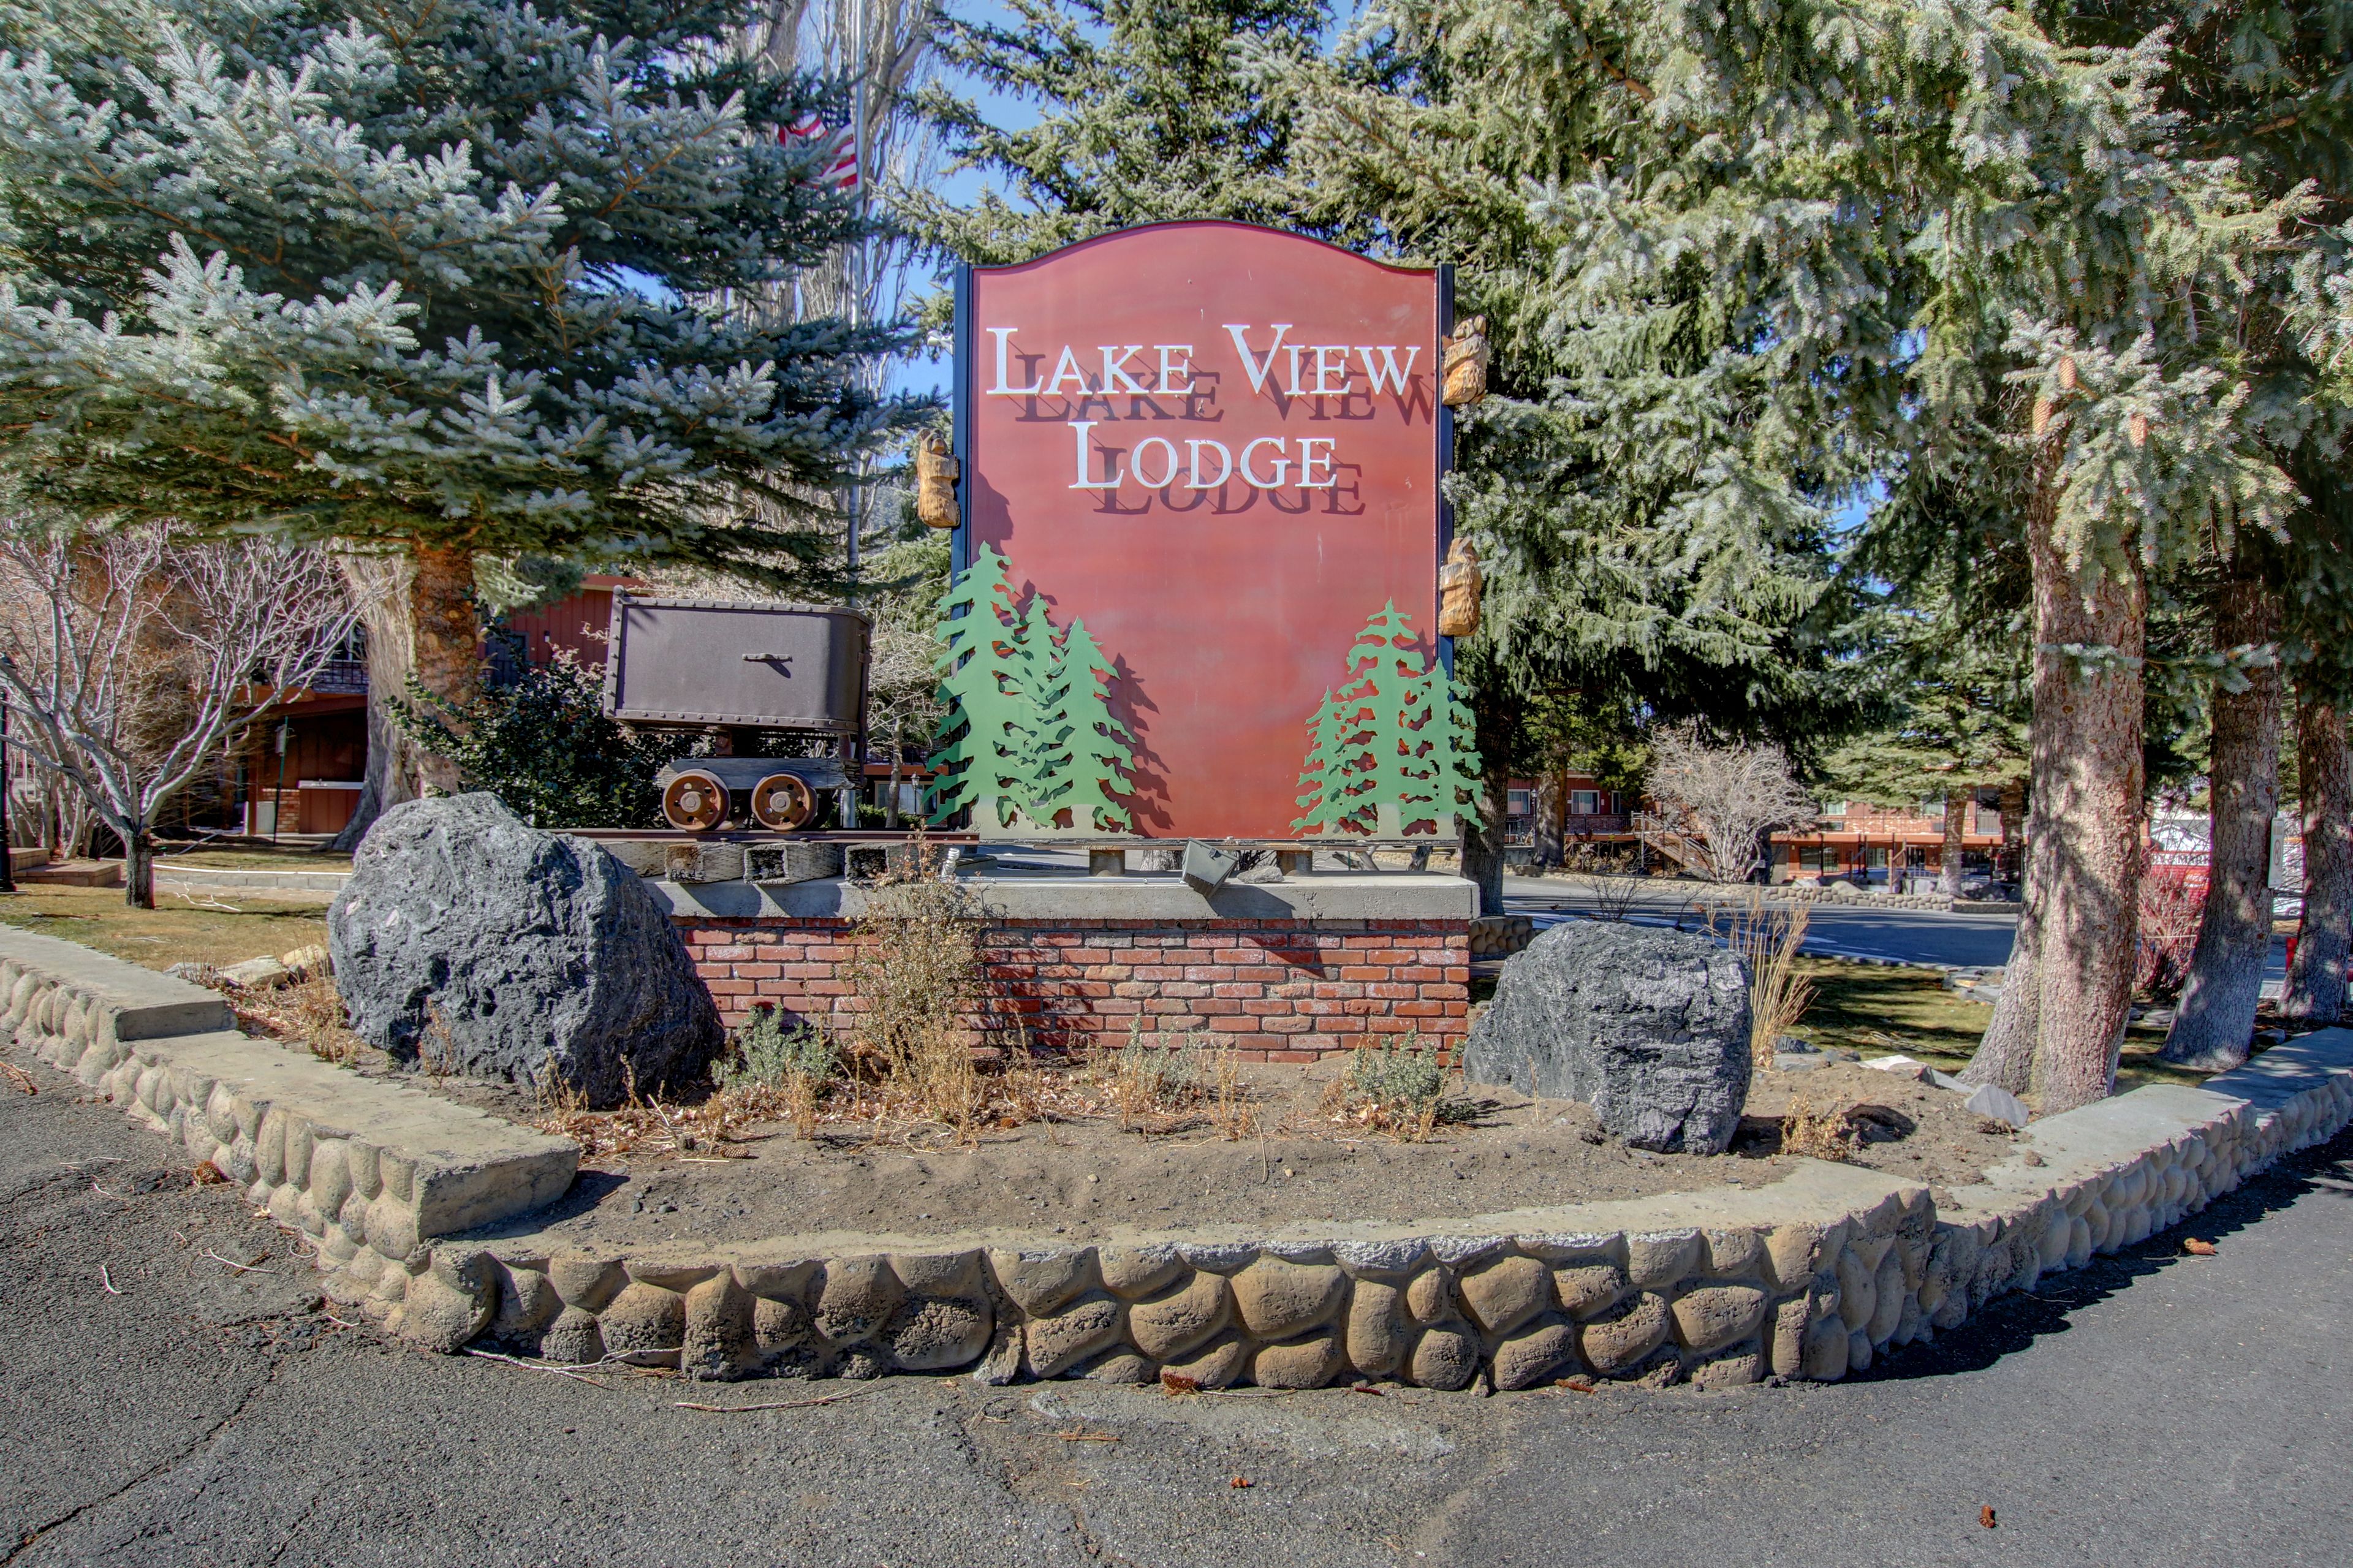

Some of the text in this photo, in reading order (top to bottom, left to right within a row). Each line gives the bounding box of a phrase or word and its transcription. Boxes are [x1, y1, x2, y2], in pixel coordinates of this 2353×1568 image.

[986, 324, 1421, 396] LAKE VIEW
[1068, 421, 1337, 489] LODGE
